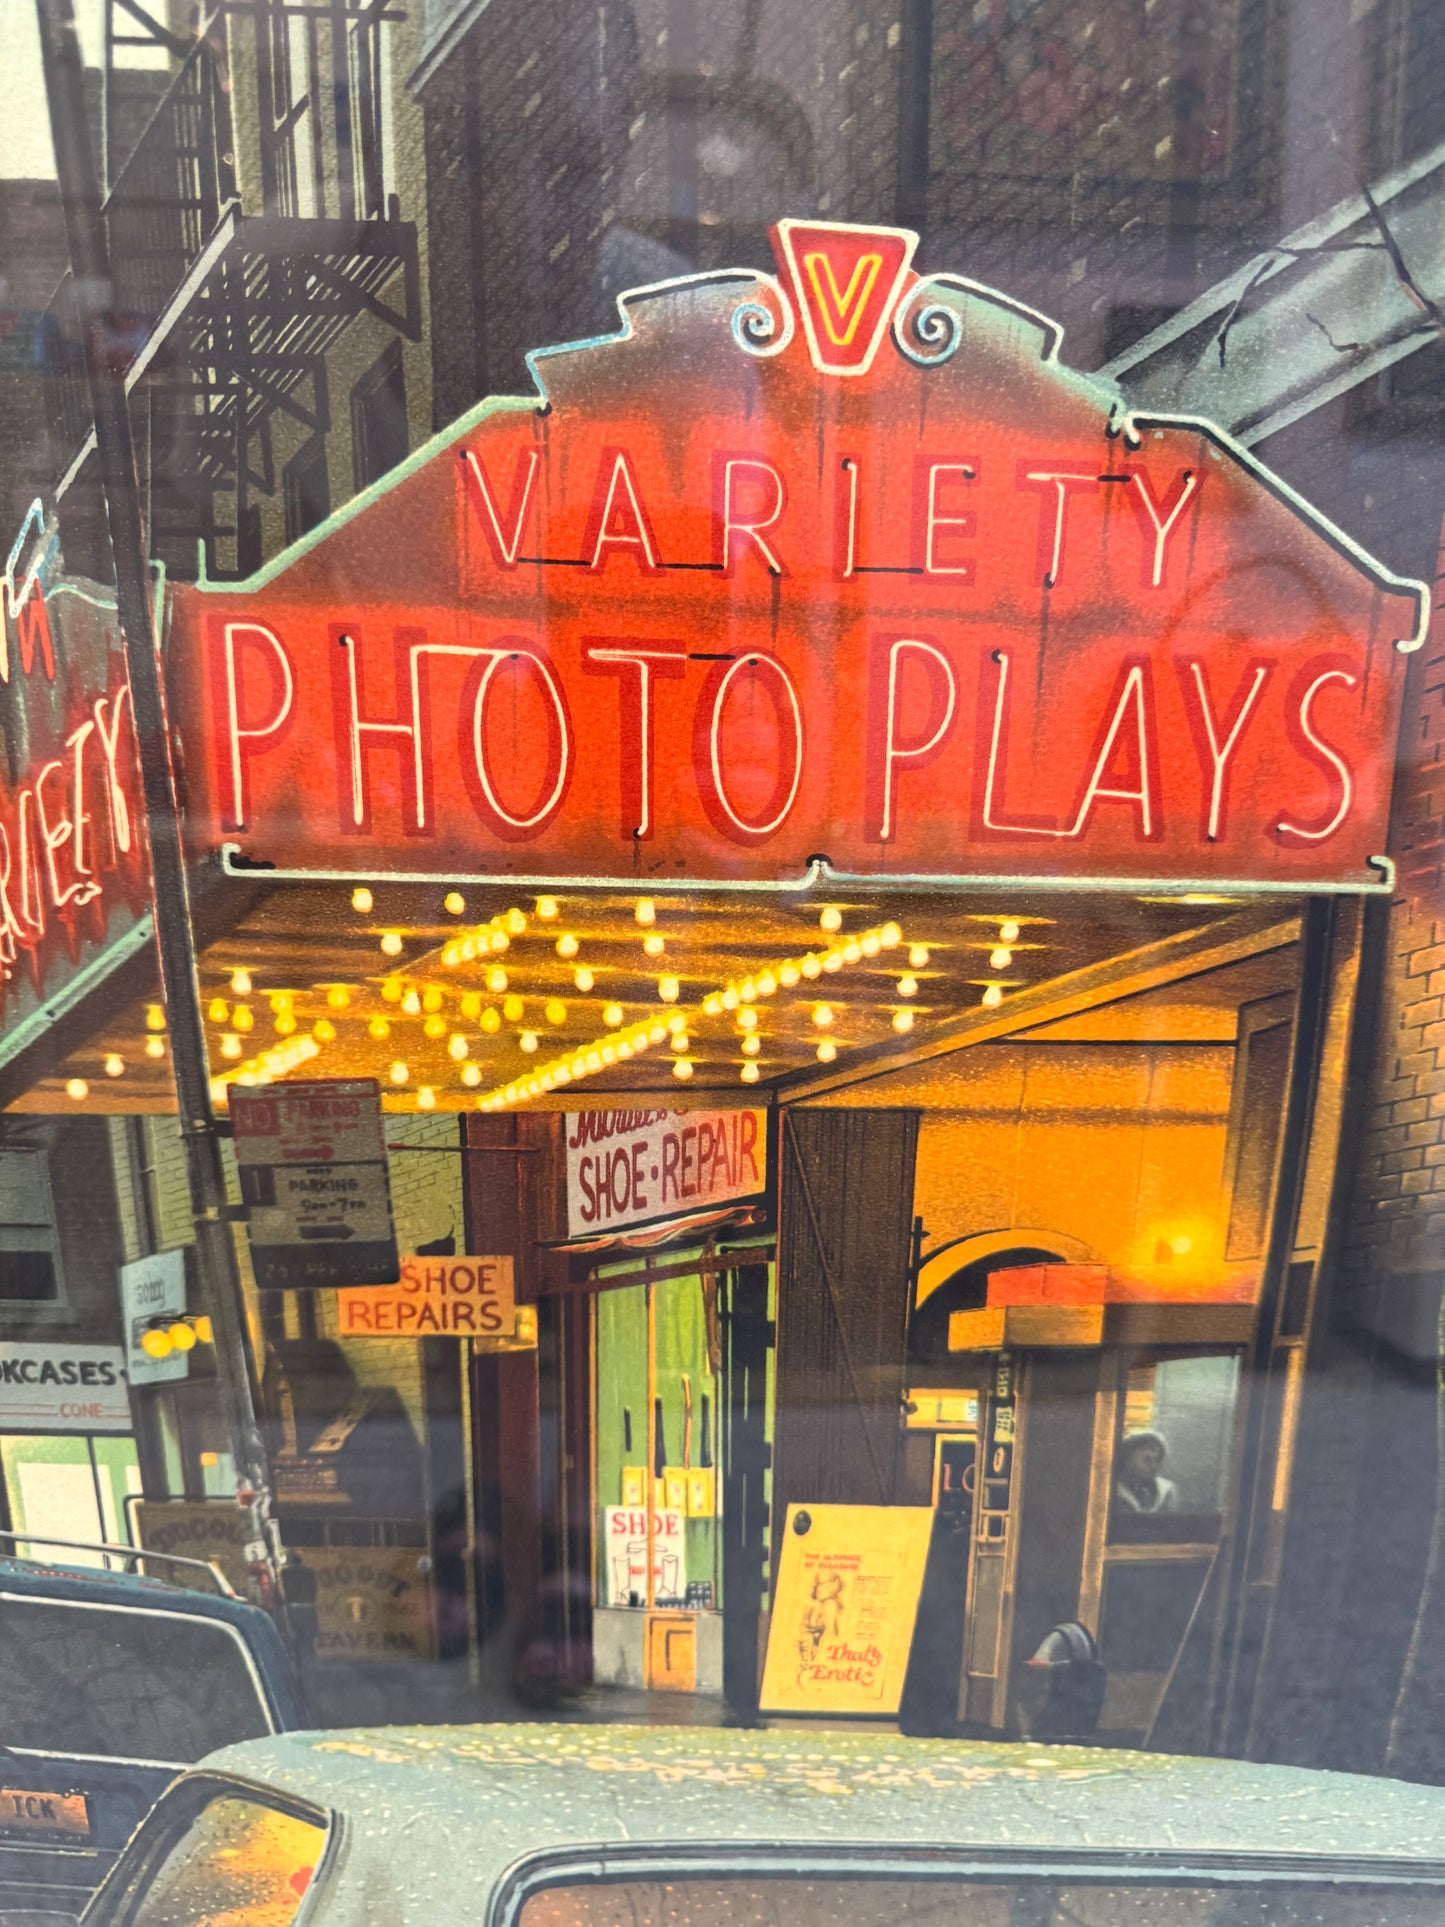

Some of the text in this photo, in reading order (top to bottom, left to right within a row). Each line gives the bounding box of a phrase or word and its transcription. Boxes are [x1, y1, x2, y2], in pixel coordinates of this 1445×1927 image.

[804, 253, 883, 346] V
[461, 446, 1199, 588] VARIETY
[206, 615, 806, 847] PHOTO
[864, 632, 1370, 850] PLAYS
[289, 1177, 359, 1194] PARKING
[400, 1263, 498, 1297] SHOE
[348, 1299, 503, 1332] REPAIRS
[0, 1357, 117, 1387] KCASES
[611, 1510, 679, 1536] SHOE
[808, 1663, 876, 1688] Erotic
